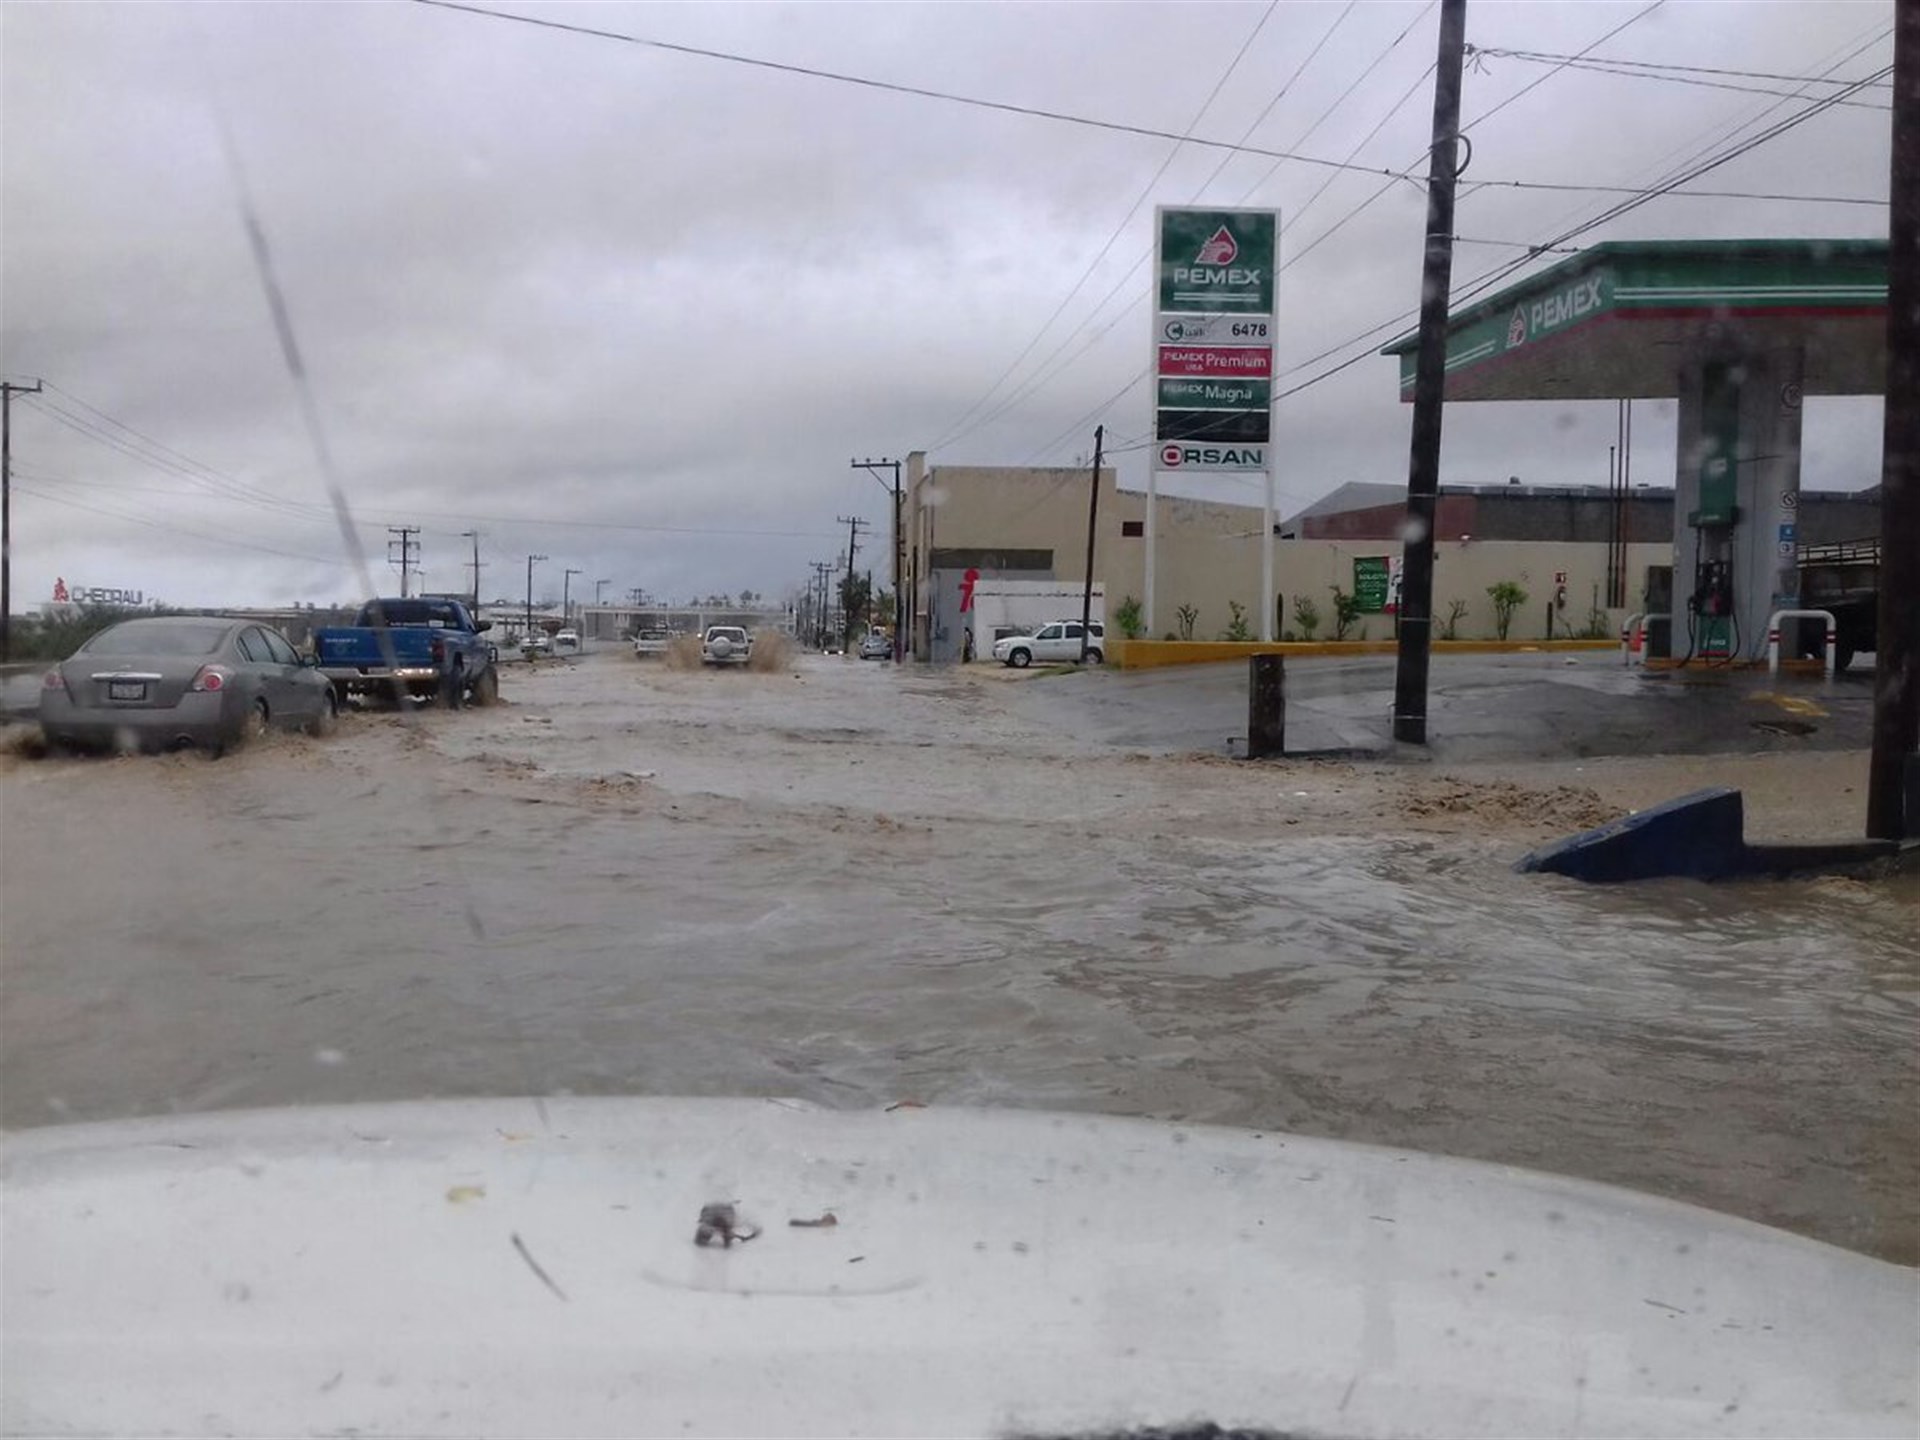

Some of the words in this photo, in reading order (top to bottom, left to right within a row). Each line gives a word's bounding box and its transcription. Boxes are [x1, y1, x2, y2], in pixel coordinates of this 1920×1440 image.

[1173, 267, 1261, 285] PEMEX
[1531, 276, 1602, 334] PEMEX
[1231, 323, 1267, 337] 6478
[1163, 352, 1204, 362] PEMEX
[1205, 353, 1267, 368] Premium
[1204, 385, 1252, 403] Magna
[1161, 445, 1262, 467] ORSAN
